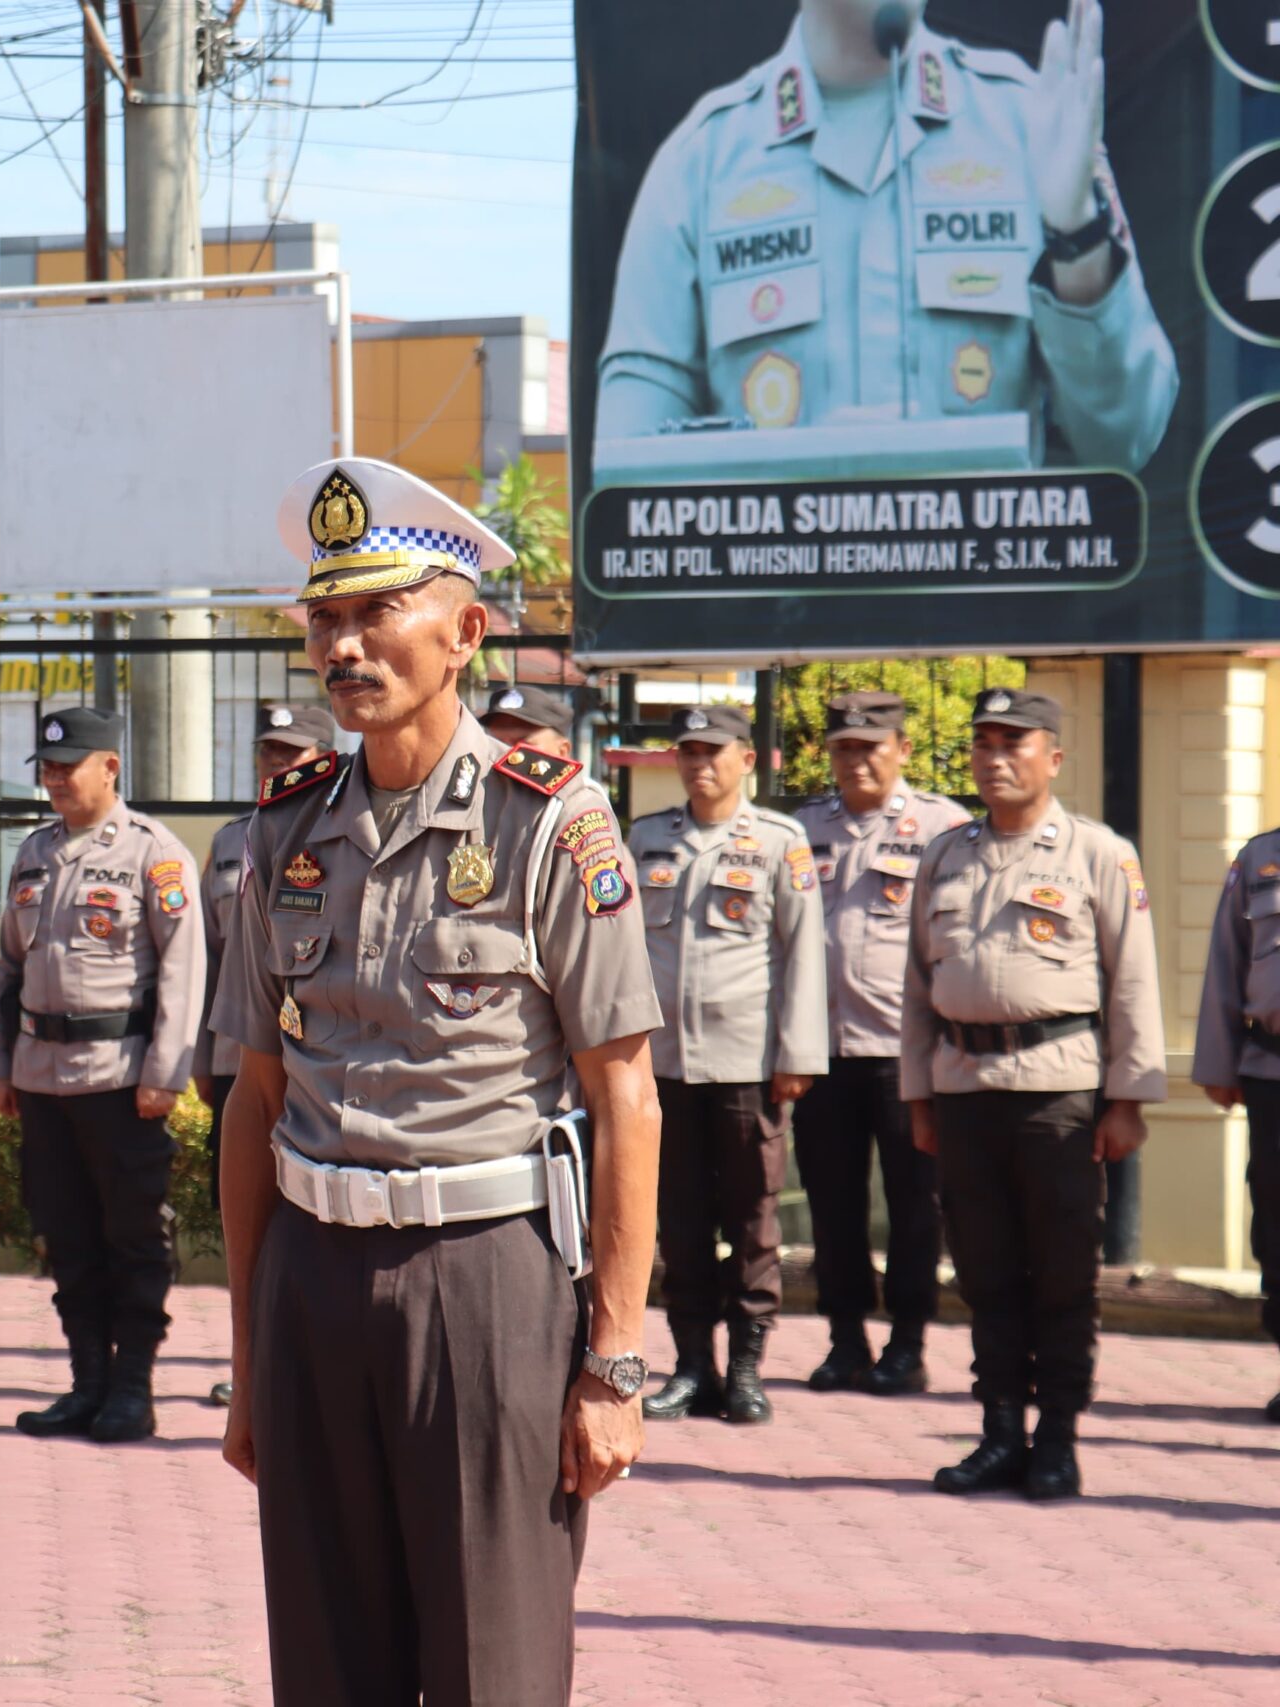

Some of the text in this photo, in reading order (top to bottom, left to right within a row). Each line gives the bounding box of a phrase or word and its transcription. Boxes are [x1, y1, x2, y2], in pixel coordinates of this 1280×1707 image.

[924, 211, 1017, 242] POLRI
[716, 224, 813, 274] WHISNU
[627, 485, 1092, 537] KAPOLDA SUMATRA UTARA
[602, 547, 668, 578] IRJEN
[673, 546, 723, 577] POL.
[727, 543, 819, 576] WHISNU
[823, 539, 958, 574] HERMAWAN
[1065, 536, 1119, 568] M.H.
[719, 853, 767, 869] POLRI
[83, 867, 135, 887] POLRI
[1027, 872, 1084, 888] POLRI
